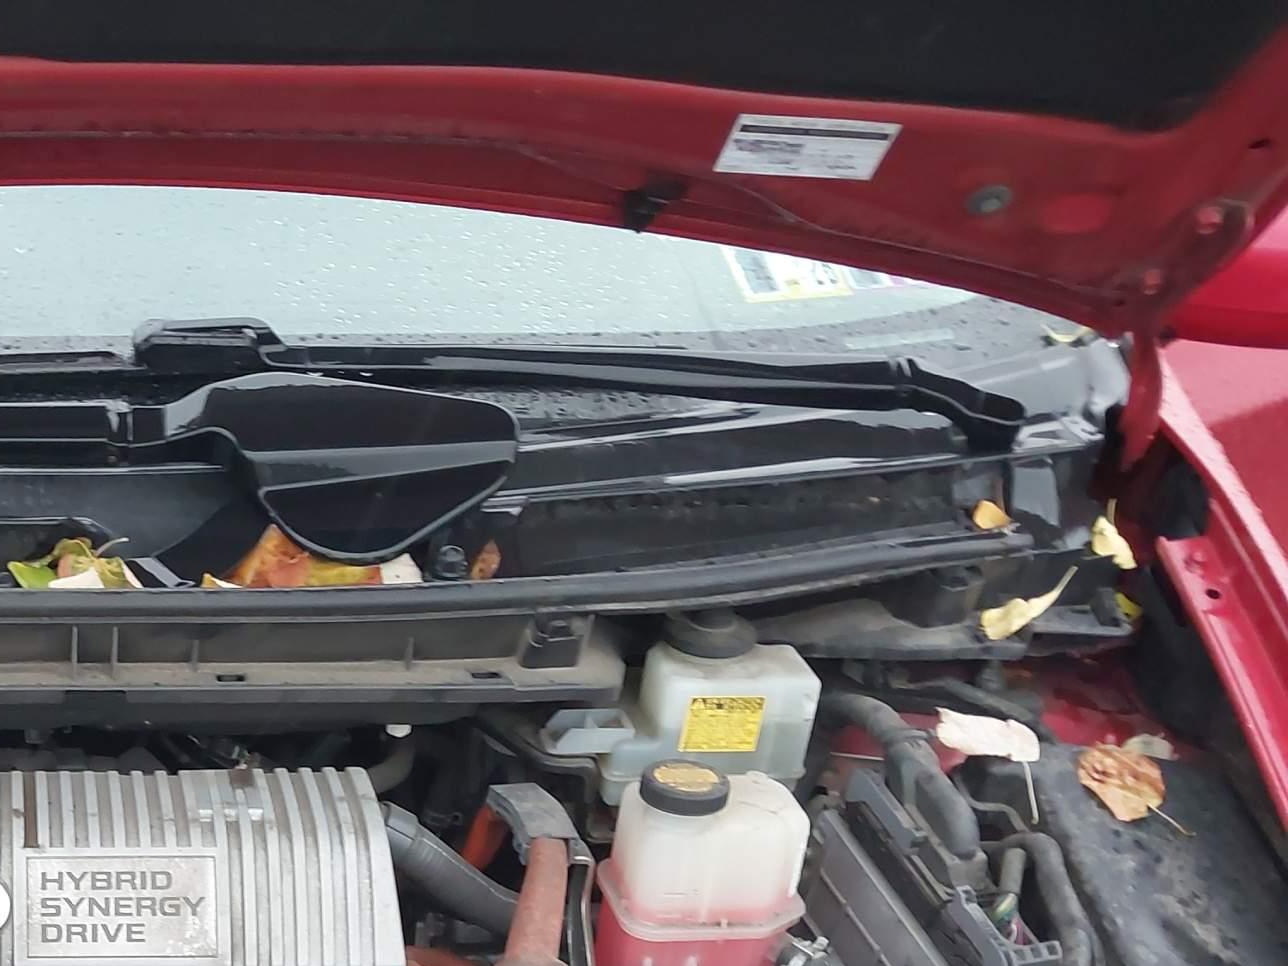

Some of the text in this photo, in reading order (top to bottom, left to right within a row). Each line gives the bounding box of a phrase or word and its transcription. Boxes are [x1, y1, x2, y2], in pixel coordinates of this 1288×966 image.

[40, 870, 173, 891] HYBRID
[40, 896, 206, 918] SYNERGY
[40, 922, 147, 944] DRIVE
